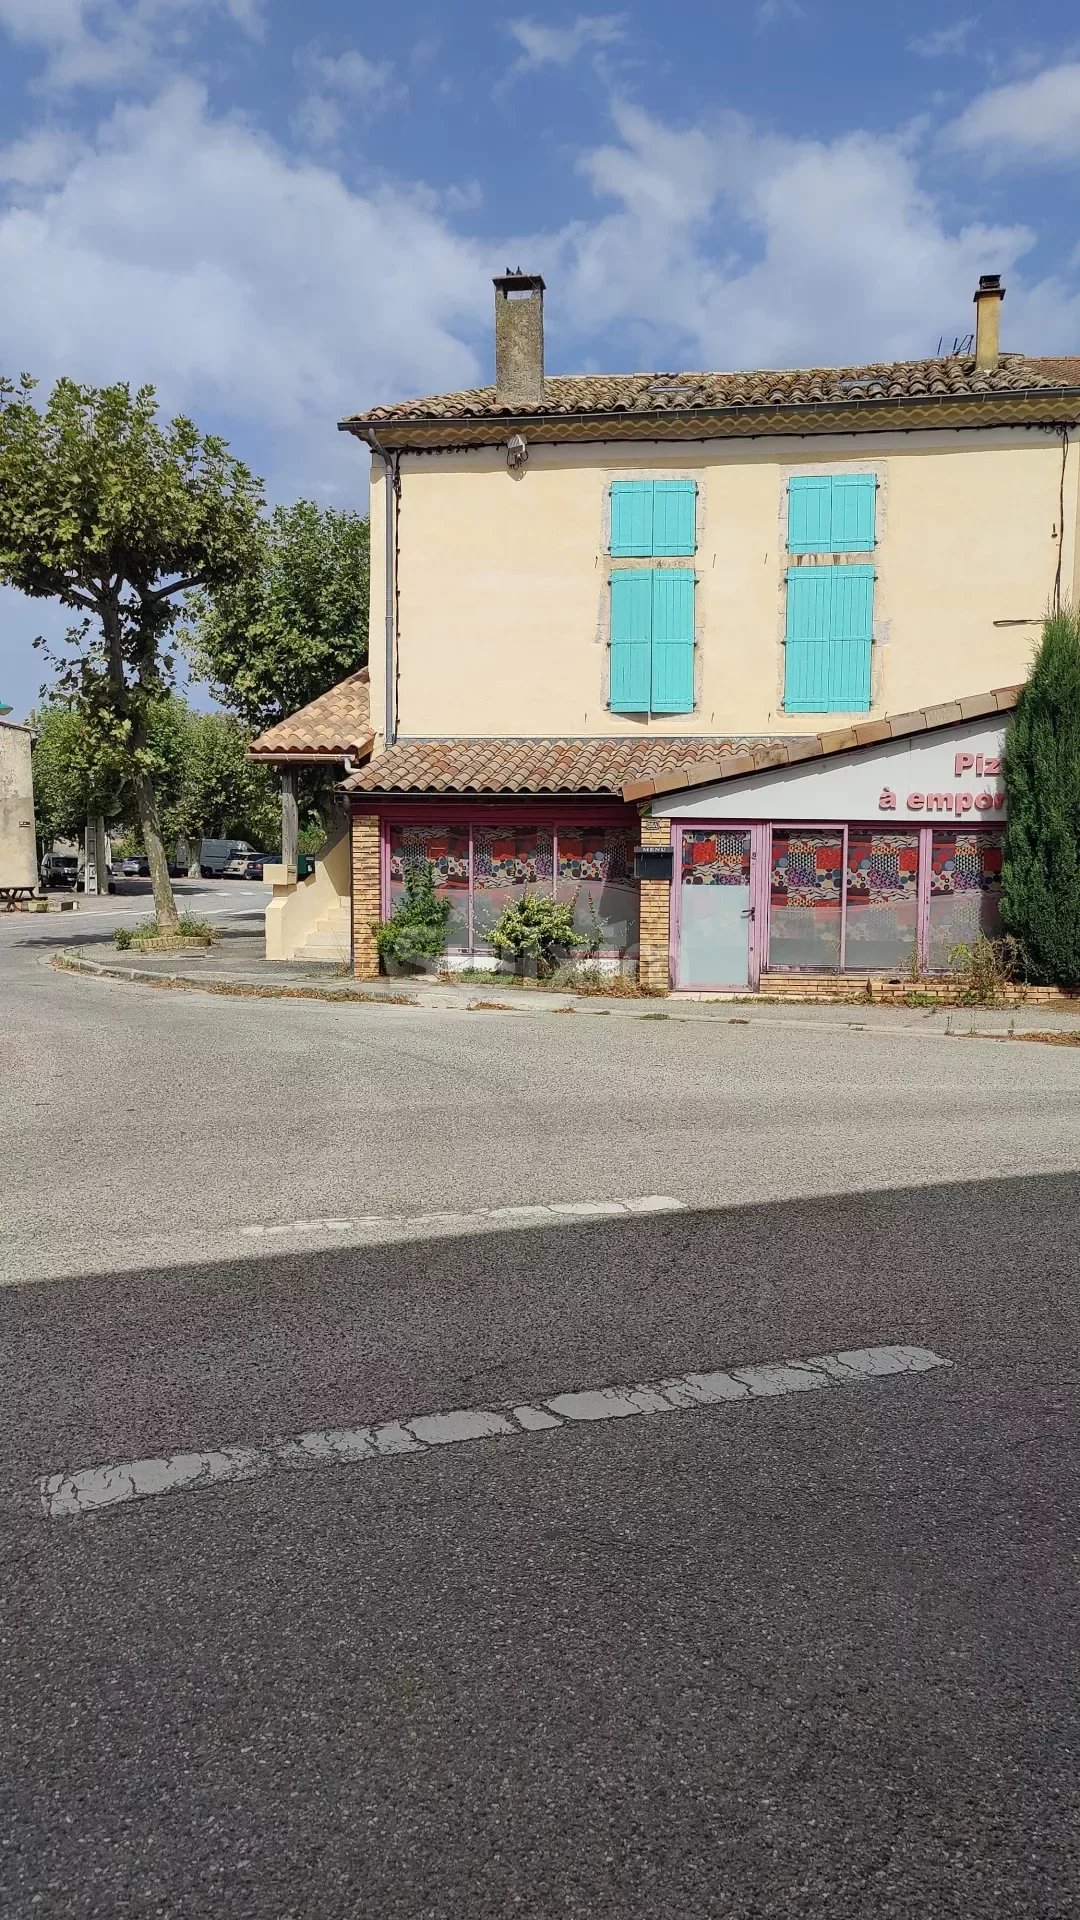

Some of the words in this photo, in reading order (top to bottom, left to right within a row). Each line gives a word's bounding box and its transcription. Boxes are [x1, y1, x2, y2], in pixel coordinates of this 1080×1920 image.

[954, 752, 1002, 778] Piz
[879, 786, 897, 811] à
[907, 792, 1006, 818] empor
